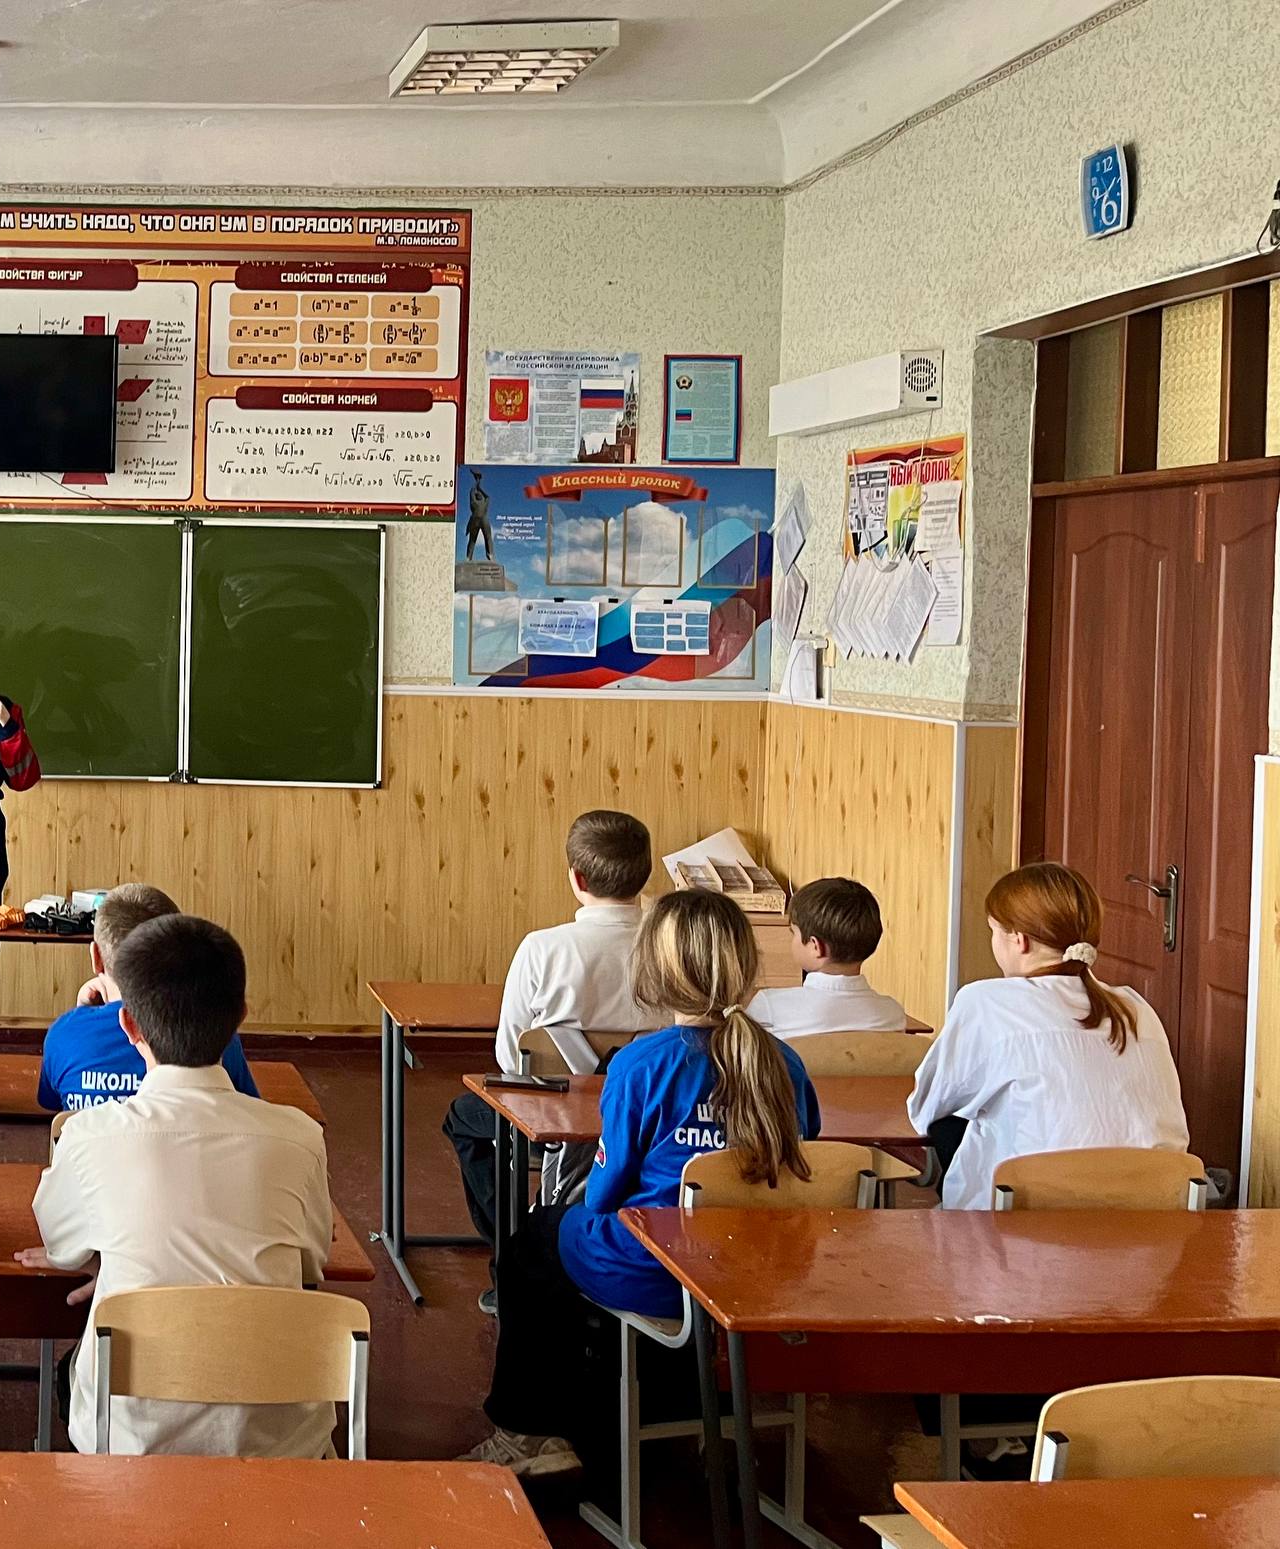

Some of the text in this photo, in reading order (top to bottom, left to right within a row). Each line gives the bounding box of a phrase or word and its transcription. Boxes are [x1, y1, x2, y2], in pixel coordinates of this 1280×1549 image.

[1102, 156, 1113, 174] 12
[1101, 197, 1118, 226] 6
[21, 213, 77, 229] УЧИТЬ
[82, 214, 134, 232] НАДО,
[141, 214, 174, 230] ЧТО
[180, 215, 214, 231] ОНА
[220, 216, 247, 232] УМ
[252, 216, 269, 232] В
[272, 217, 353, 233] ПОРЯДОК
[358, 218, 459, 234] ПРИВОДИТ»
[400, 236, 458, 247] ЛОМОНОСОВ
[47, 270, 83, 281] ФИГУР
[280, 271, 387, 284] СВОЙСТВА СТЕПЕНЕЙ
[282, 392, 378, 405] СВОЙСТВА КОРНЕЙ
[552, 471, 681, 490] Классный уголок
